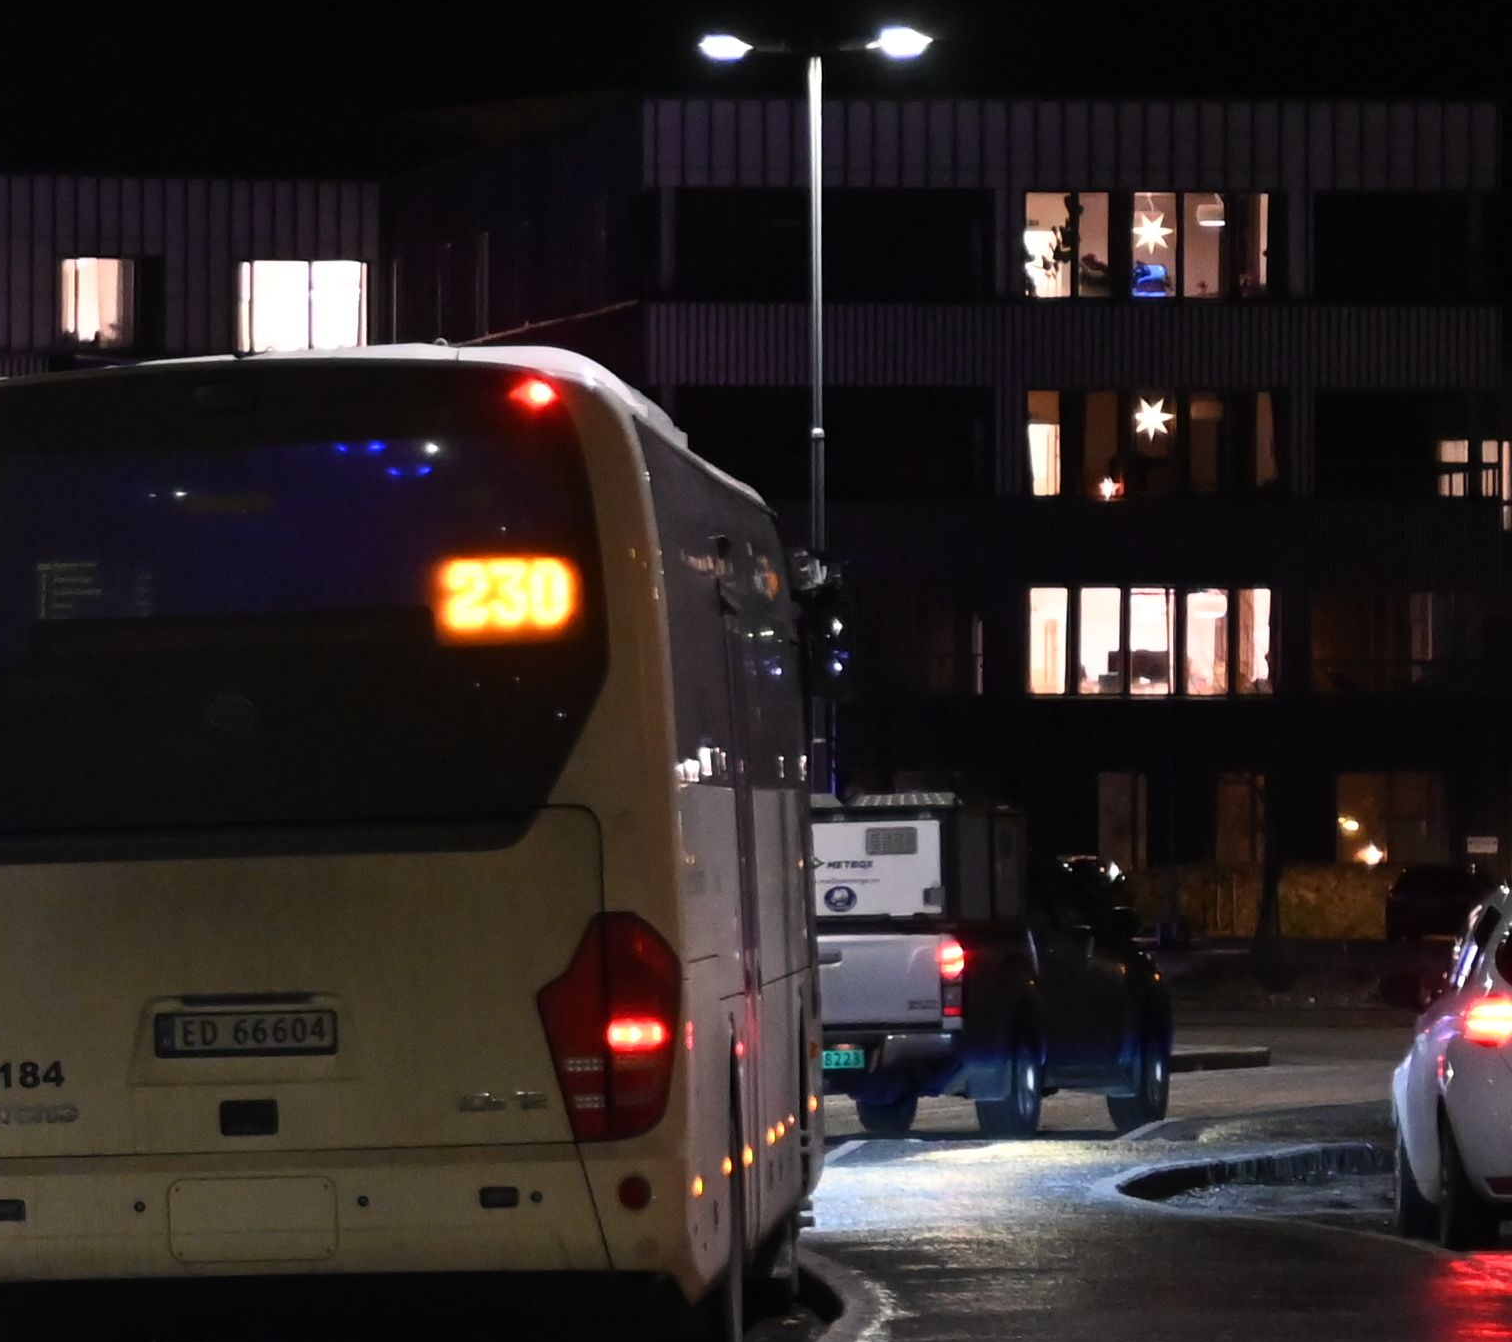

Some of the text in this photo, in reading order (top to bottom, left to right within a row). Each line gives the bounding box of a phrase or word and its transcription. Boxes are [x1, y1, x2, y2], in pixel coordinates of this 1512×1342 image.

[446, 557, 571, 630] 230
[182, 1017, 326, 1046] ED 66604
